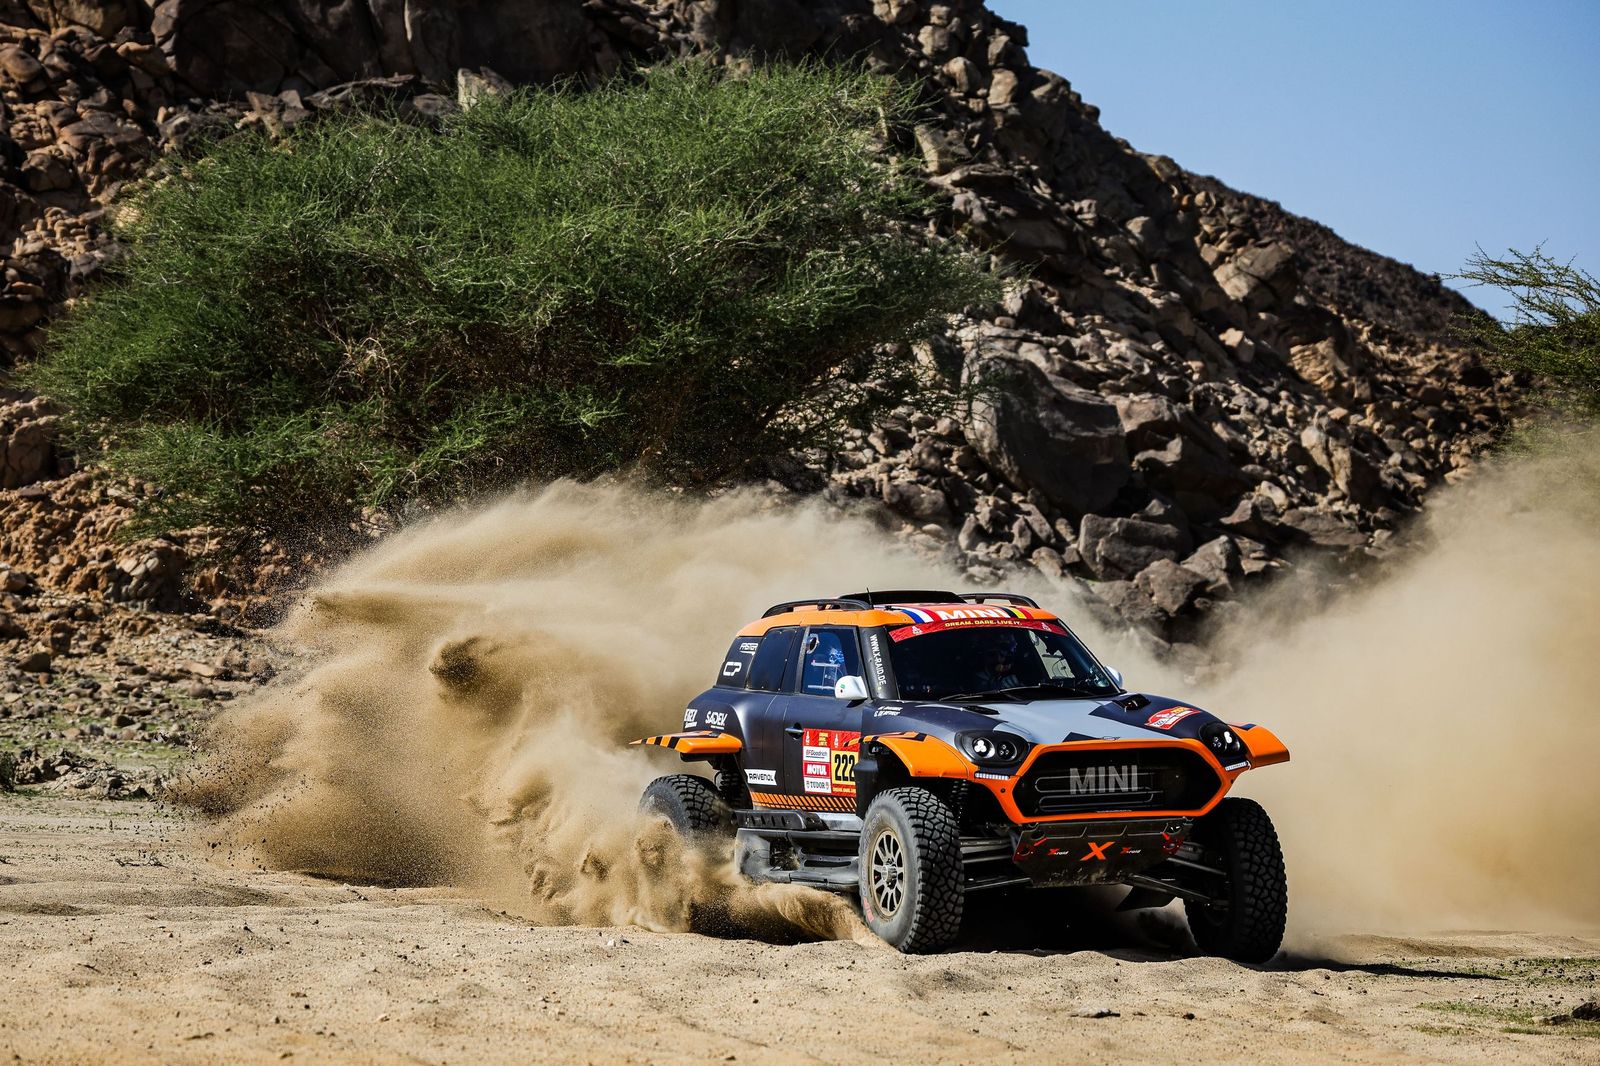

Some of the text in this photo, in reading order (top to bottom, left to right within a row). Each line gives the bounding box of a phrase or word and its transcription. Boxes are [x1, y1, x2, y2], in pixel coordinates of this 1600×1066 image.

[935, 609, 1011, 620] MINI
[869, 633, 887, 686] WWW.X-RAID.DE
[705, 710, 728, 726] SADEV
[805, 749, 828, 757] BFGoodrich
[806, 763, 827, 776] MOTUL
[834, 753, 856, 782] 222
[748, 773, 774, 782] RAVENOL
[1069, 764, 1138, 795] MINI
[810, 780, 826, 790] TUDOR
